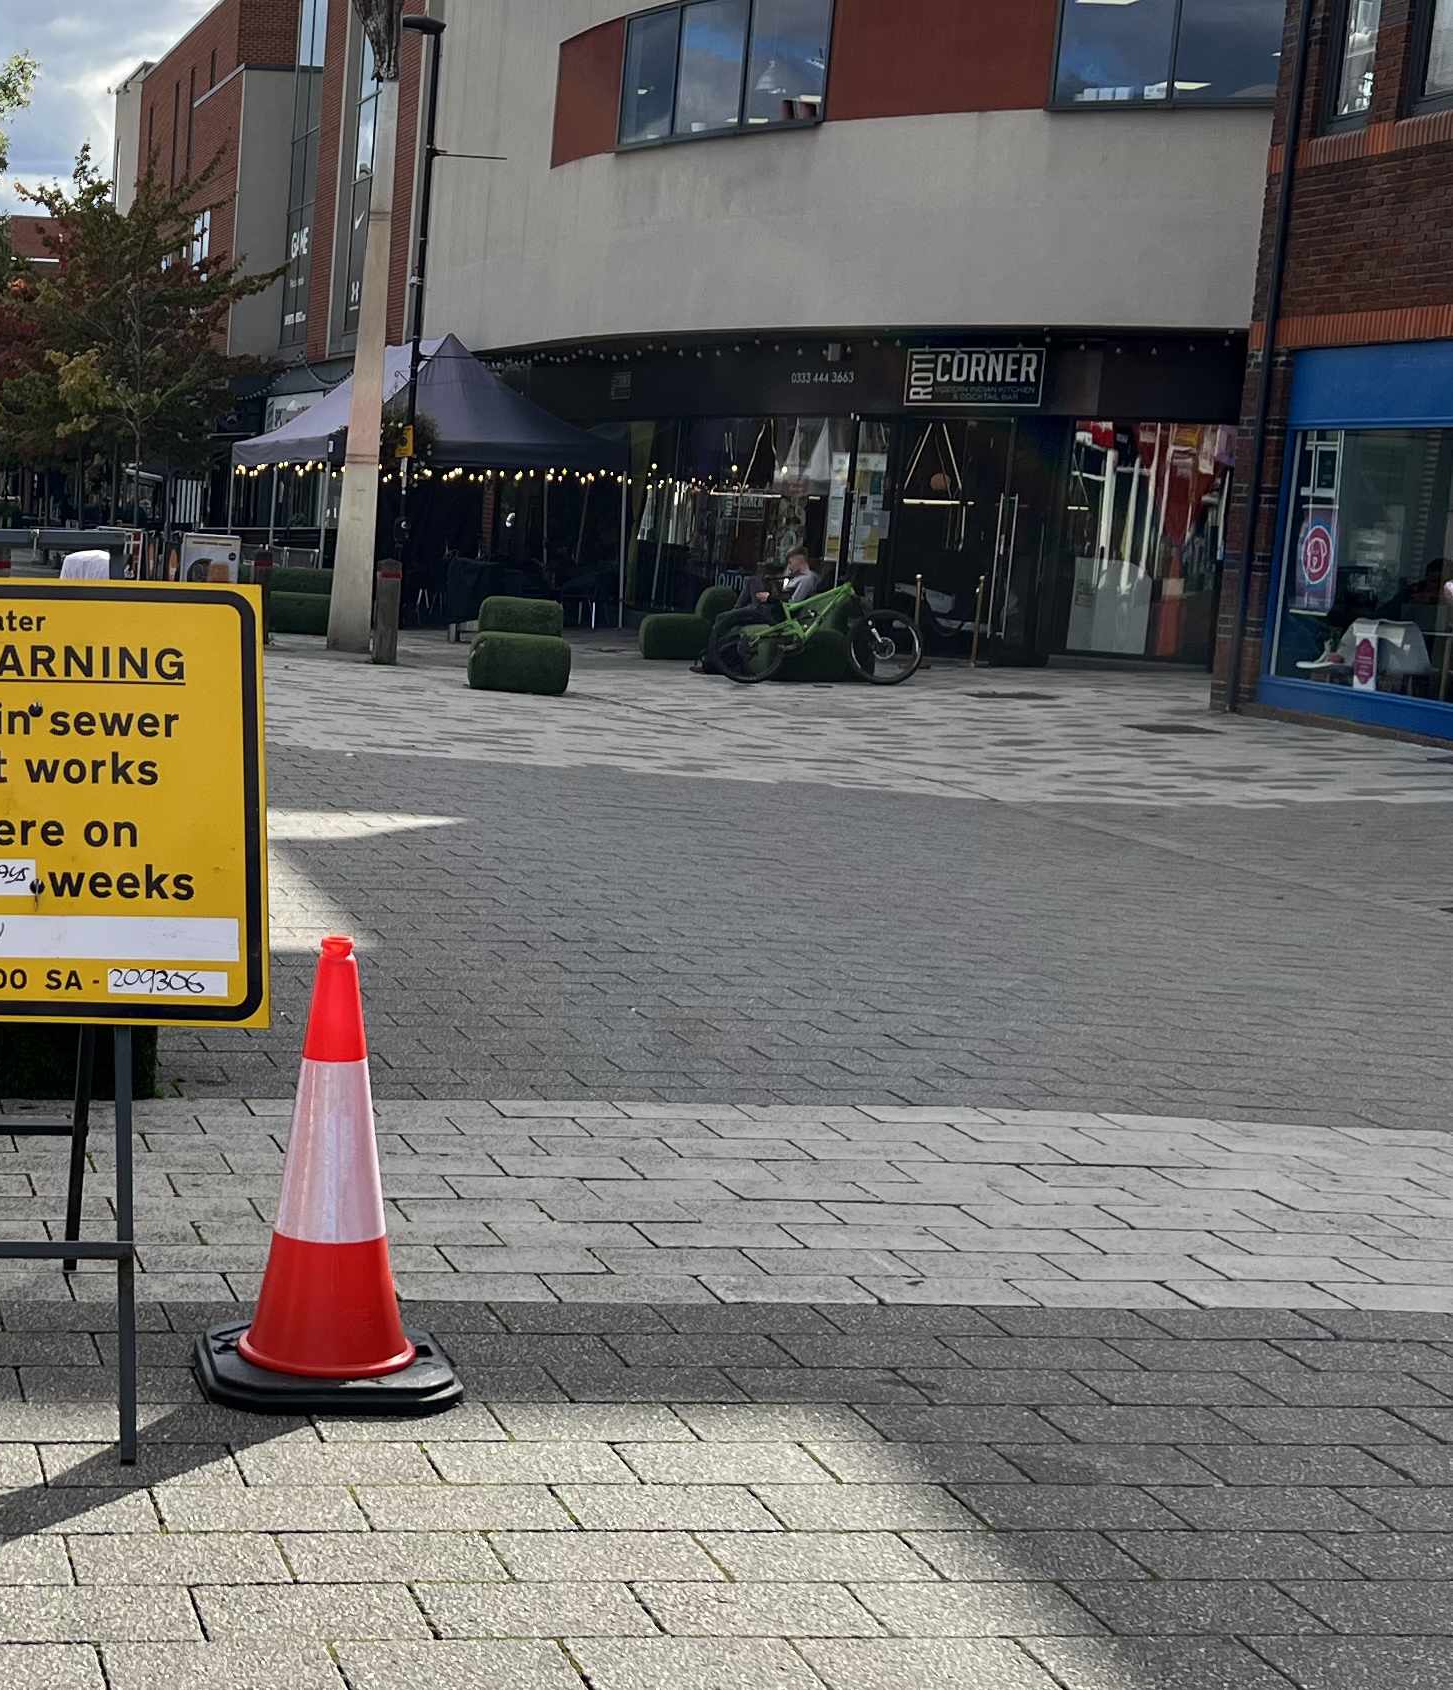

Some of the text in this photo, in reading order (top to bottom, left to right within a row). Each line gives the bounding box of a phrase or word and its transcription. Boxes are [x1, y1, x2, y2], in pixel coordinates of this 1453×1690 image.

[791, 371, 811, 384] 0333
[812, 371, 829, 384] 444
[909, 353, 1038, 400] ROTI CORNER
[49, 710, 180, 738] sewer
[24, 751, 159, 786] works
[83, 818, 138, 848] on
[47, 863, 196, 901] weeks
[44, 969, 84, 991] SA
[108, 967, 206, 995] 209306
